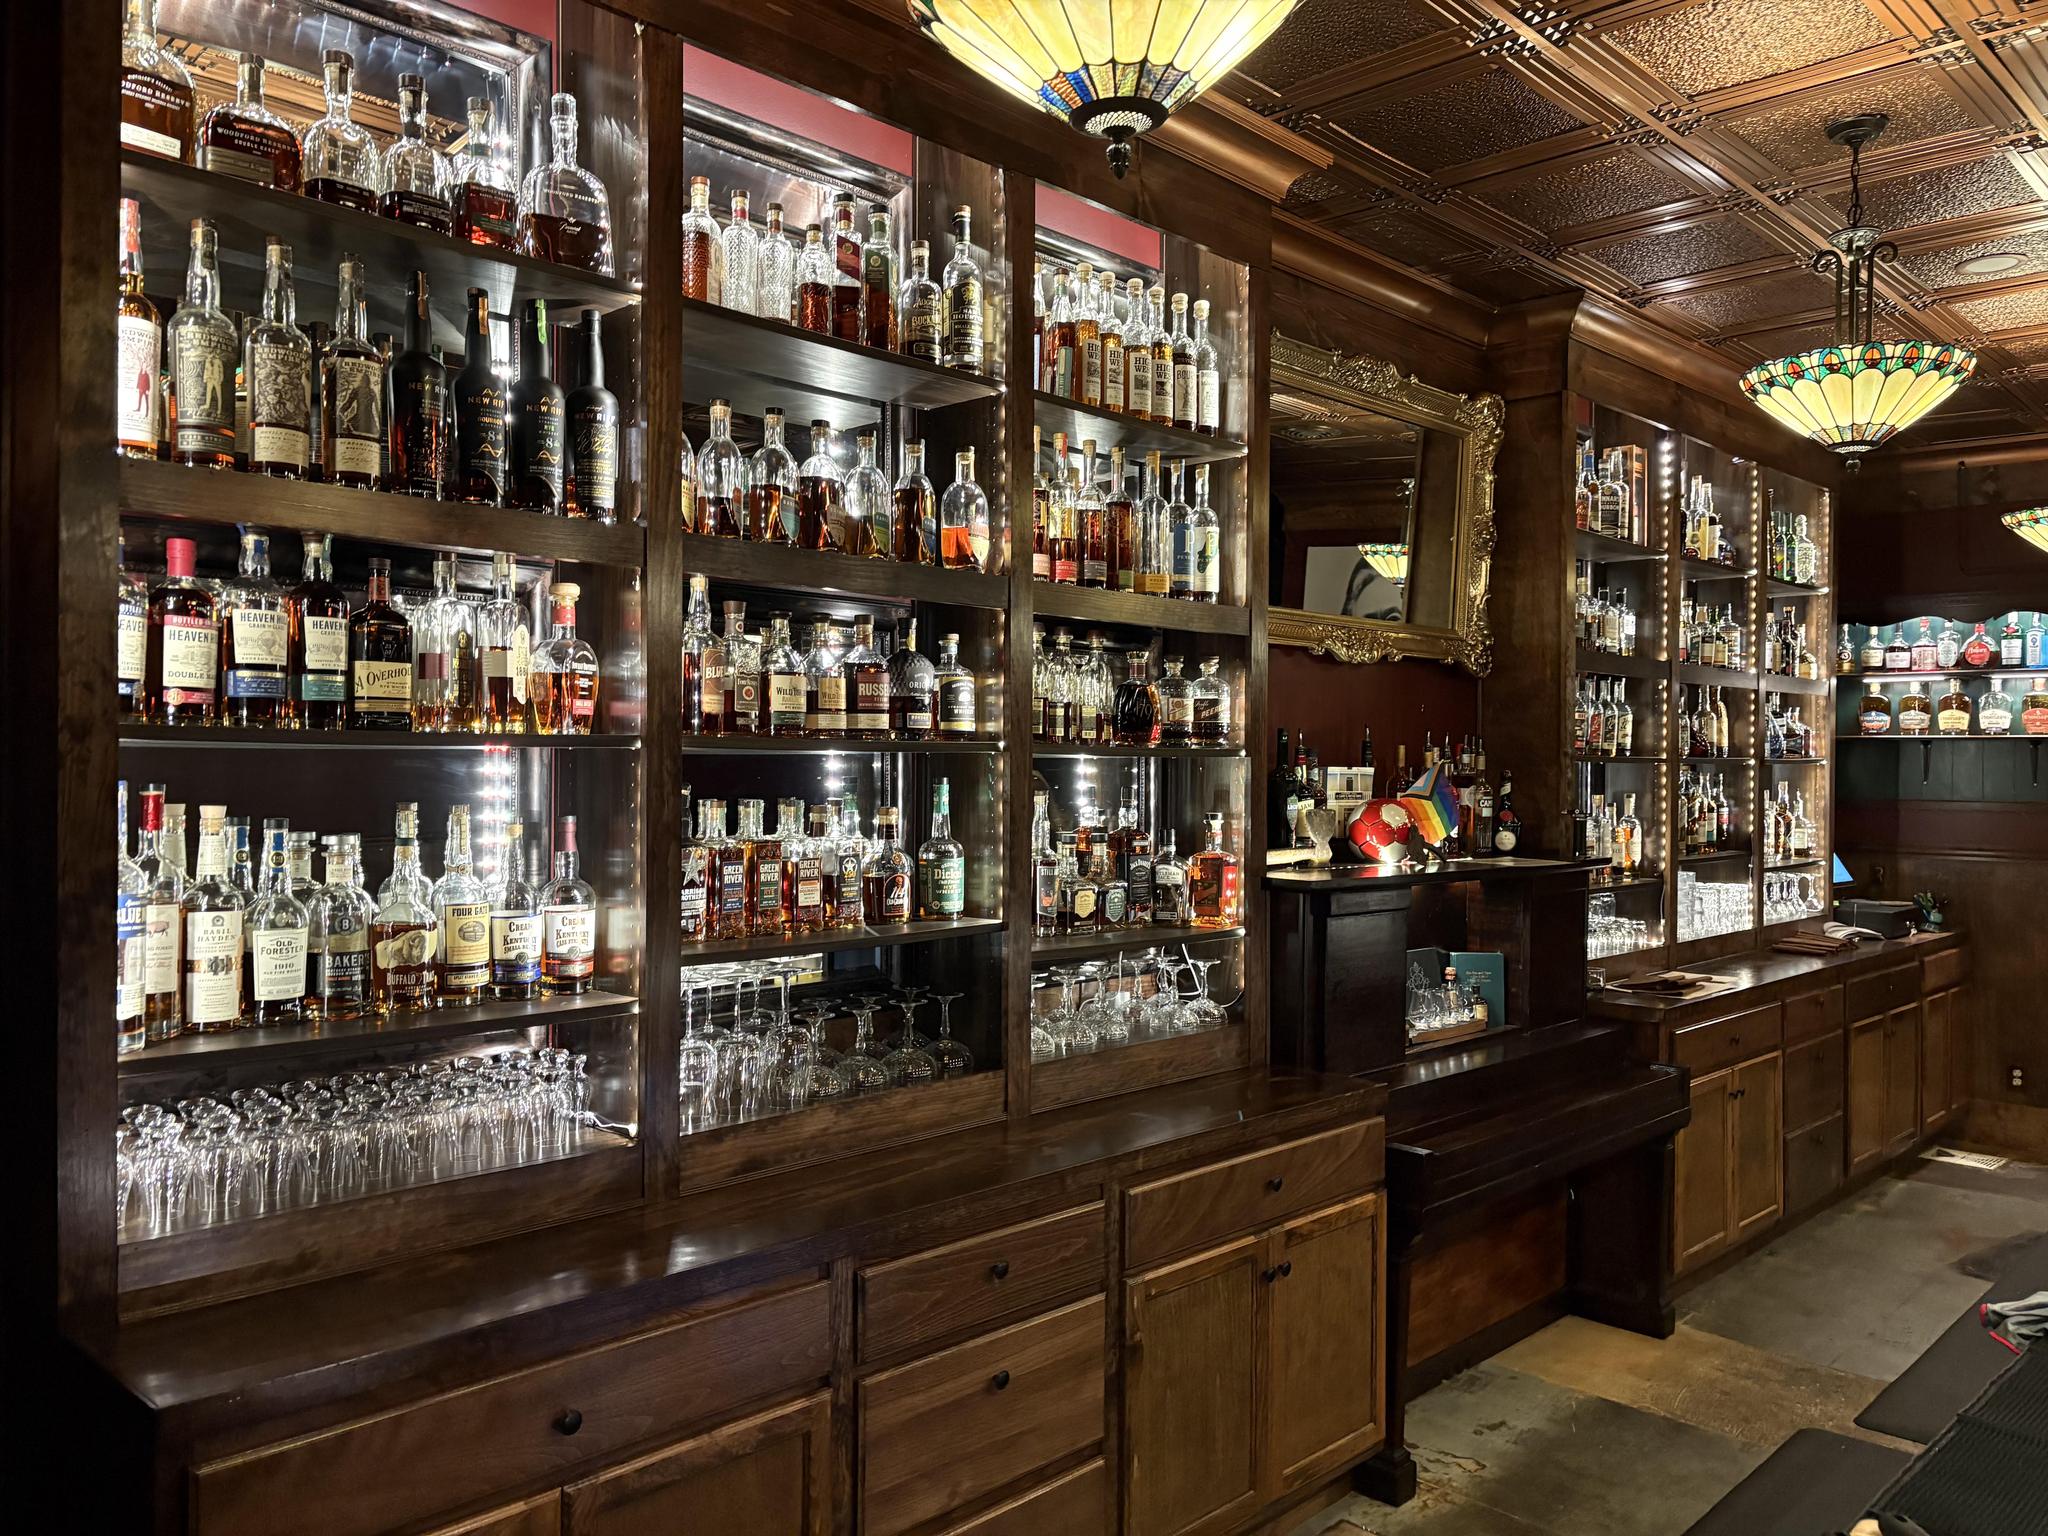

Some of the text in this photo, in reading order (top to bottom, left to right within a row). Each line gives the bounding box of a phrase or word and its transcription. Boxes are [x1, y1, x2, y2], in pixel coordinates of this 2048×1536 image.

[121, 80, 153, 95] ODFORD
[217, 127, 261, 142] WOODFORD
[1087, 342, 1100, 352] HIG
[1109, 350, 1122, 359] HIG
[1134, 356, 1150, 366] HIG
[1156, 363, 1171, 372] HIG
[487, 430, 497, 441] 8
[545, 436, 554, 449] 8
[172, 615, 203, 626] BOTTLED
[240, 612, 275, 624] HEAVEN
[312, 619, 343, 631] HEAVEN
[168, 629, 209, 643] HEAVEN
[167, 670, 204, 681] DOUBLE
[723, 864, 744, 875] GREEN
[759, 863, 780, 873] GREEN
[799, 859, 820, 869] GREEN
[724, 873, 743, 884] RIVER
[760, 872, 779, 882] RIVER
[800, 868, 820, 878] RIVER
[452, 905, 473, 917] FOUR
[203, 928, 232, 936] BASIL
[197, 934, 237, 943] HAYDEN
[276, 940, 293, 948] OLD
[261, 944, 304, 955] FORESTER
[274, 962, 295, 970] 1910
[386, 971, 416, 986] BUFFALO
